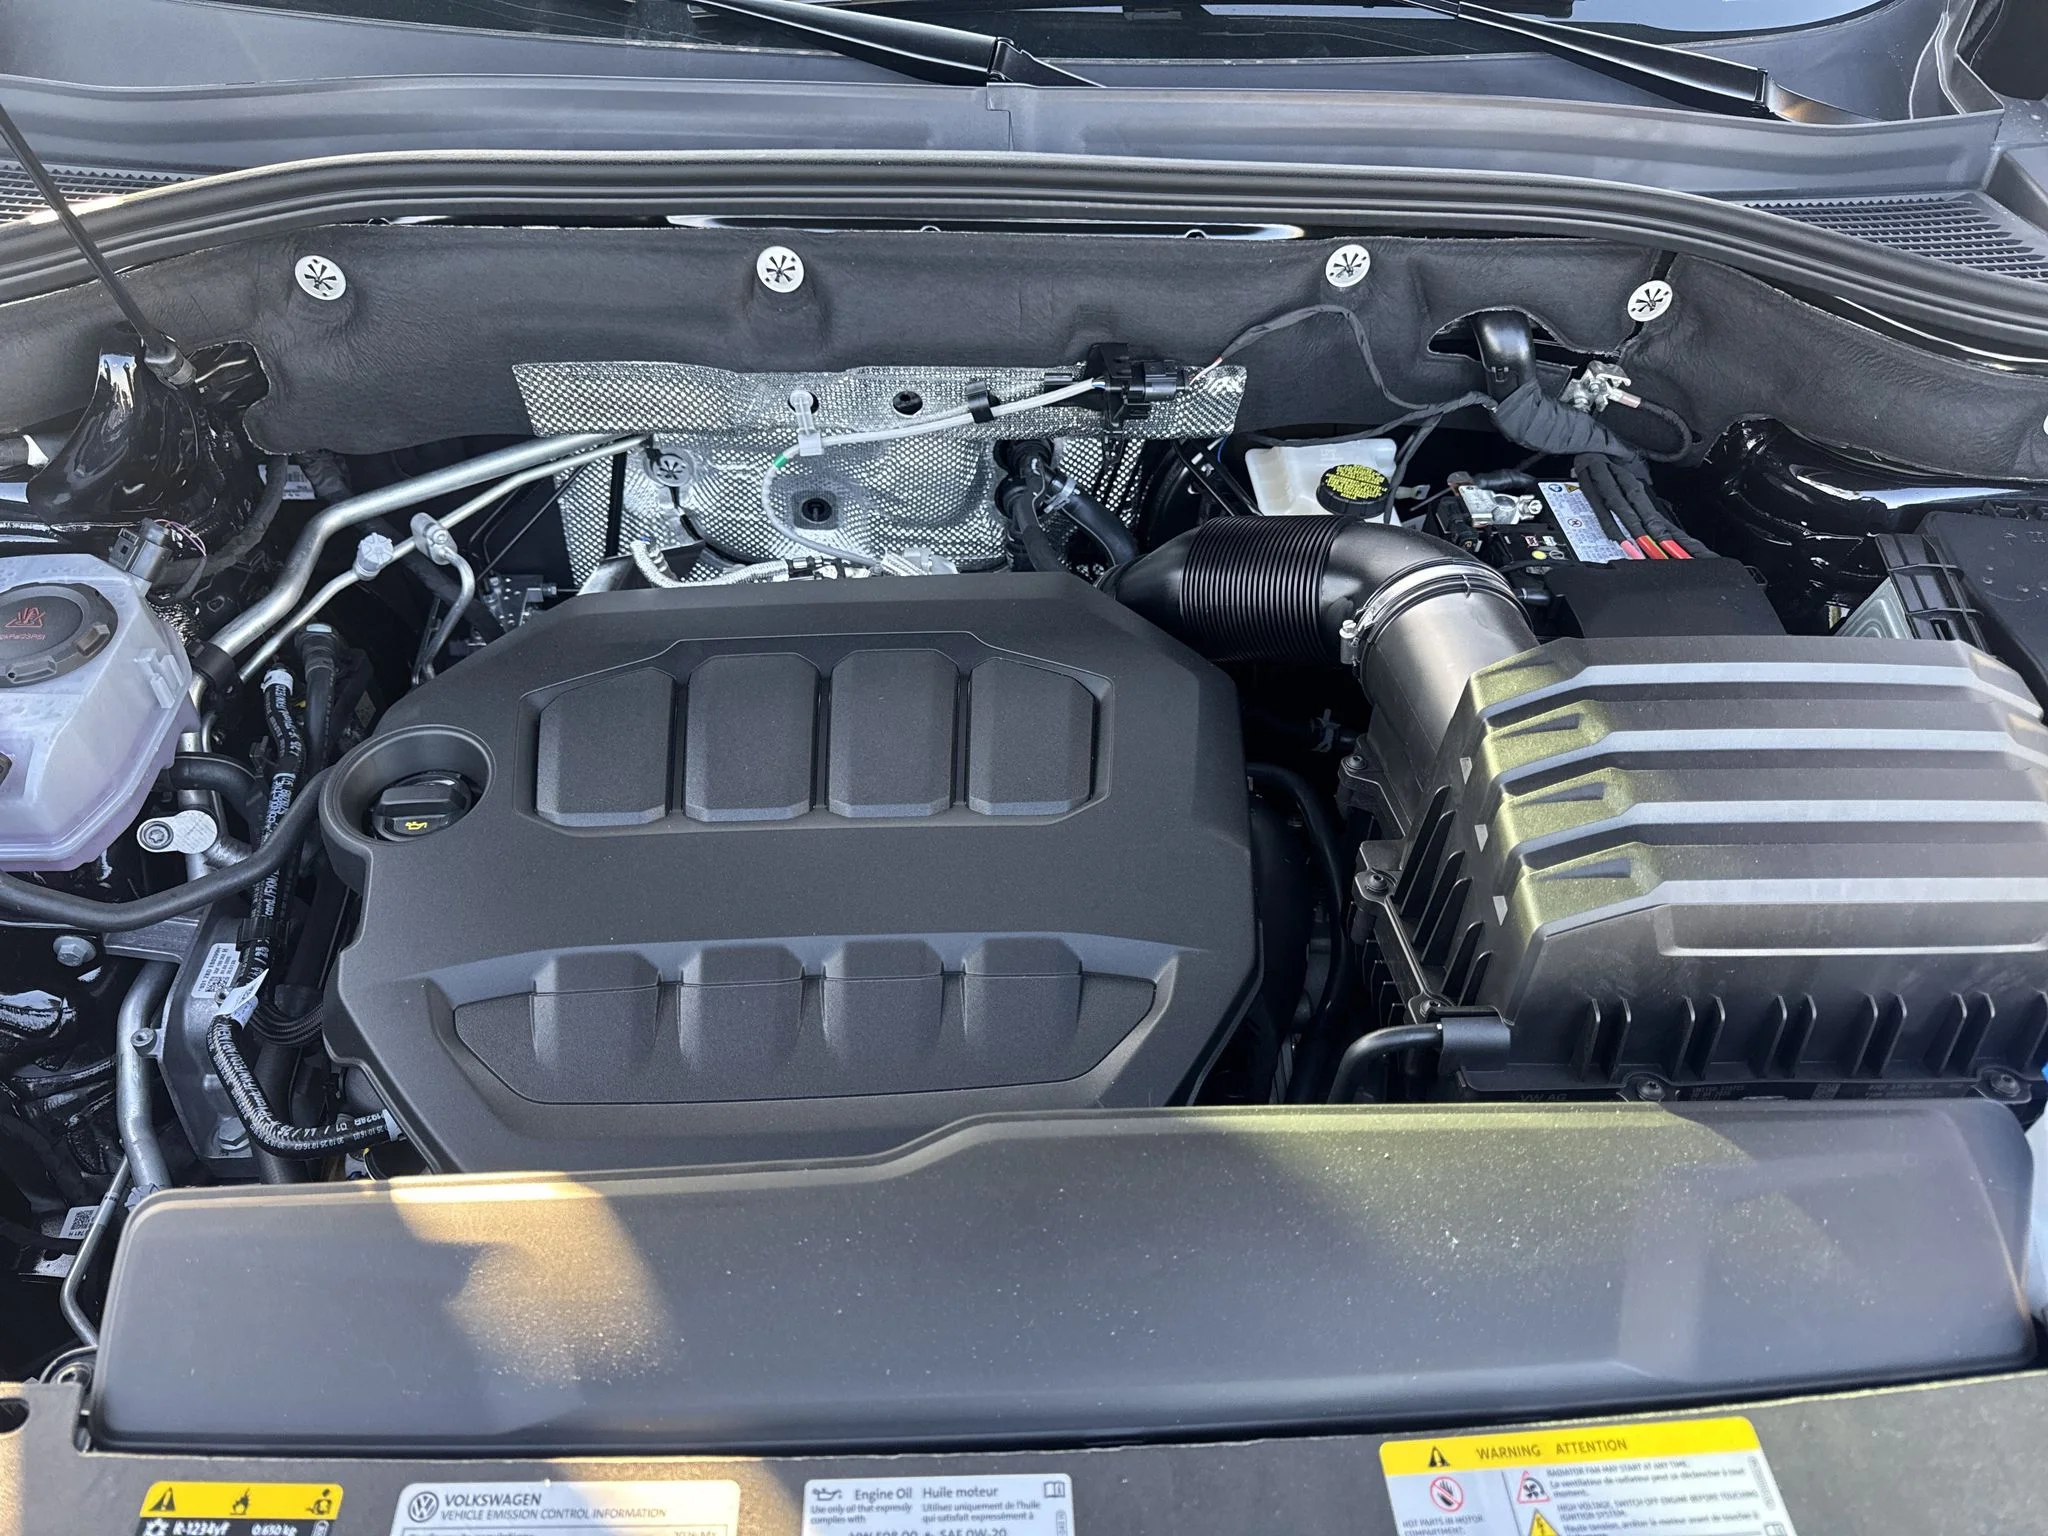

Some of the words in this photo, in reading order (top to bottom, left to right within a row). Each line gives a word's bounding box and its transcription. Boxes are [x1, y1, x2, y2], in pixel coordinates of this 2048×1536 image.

[1476, 1444, 1541, 1460] WARNING
[1556, 1438, 1628, 1455] ATTENTION
[1619, 1463, 1641, 1472] START
[444, 1493, 542, 1507] VOLKSWAGEN
[855, 1488, 894, 1503] Engine
[896, 1487, 912, 1499] Oil
[923, 1487, 953, 1499] Huile
[956, 1487, 998, 1498] moteur
[441, 1509, 484, 1521] VEHICLE
[486, 1508, 538, 1520] EMISSION
[541, 1508, 590, 1519] CONTROL
[592, 1507, 667, 1519] INFORMATION
[811, 1505, 826, 1514] Use
[827, 1504, 845, 1516] only
[846, 1503, 856, 1513] oil
[857, 1503, 873, 1513] that
[875, 1502, 912, 1515] expressly
[954, 1502, 1004, 1512] uniquement
[1005, 1501, 1015, 1510] de
[810, 1516, 845, 1525] complies
[848, 1514, 866, 1523] with
[922, 1514, 936, 1524] qui
[937, 1513, 969, 1523] satisfait
[1402, 1519, 1418, 1528] HOT
[1420, 1517, 1444, 1526] PARTS
[1444, 1517, 1453, 1525] IN
[1455, 1514, 1483, 1524] MOTOR
[172, 1520, 230, 1536] R-1234yf
